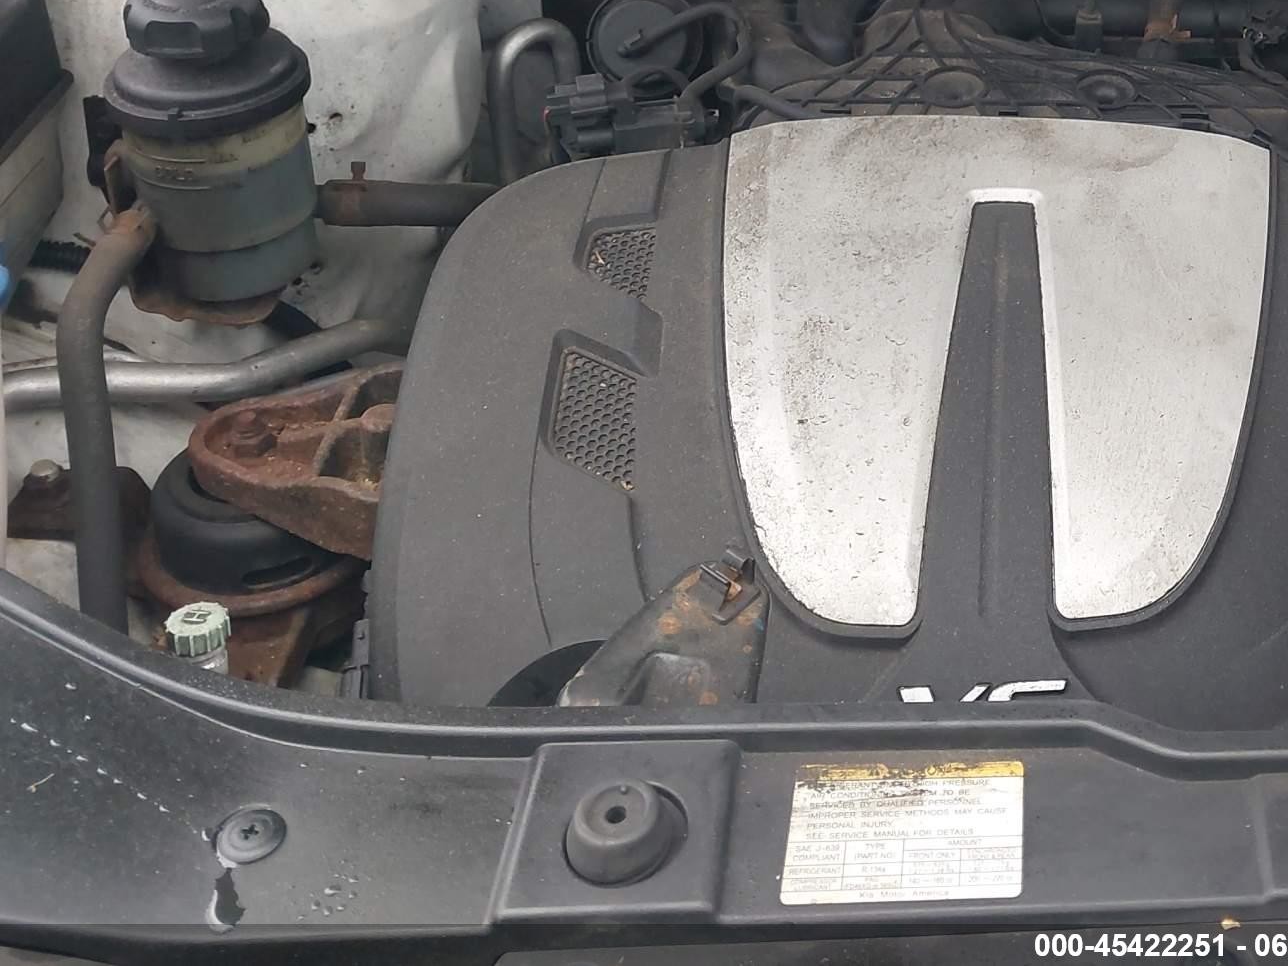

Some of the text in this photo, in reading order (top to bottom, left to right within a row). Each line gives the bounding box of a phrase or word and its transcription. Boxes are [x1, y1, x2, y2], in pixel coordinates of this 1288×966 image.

[860, 800, 873, 809] BY
[807, 811, 857, 820] IMPROPER
[861, 809, 901, 819] SERVICE
[954, 807, 973, 817] MAY
[806, 821, 856, 830] PERSONAL
[805, 831, 826, 840] SEE
[830, 830, 869, 839] SERVICE
[873, 828, 910, 838] MANUAL
